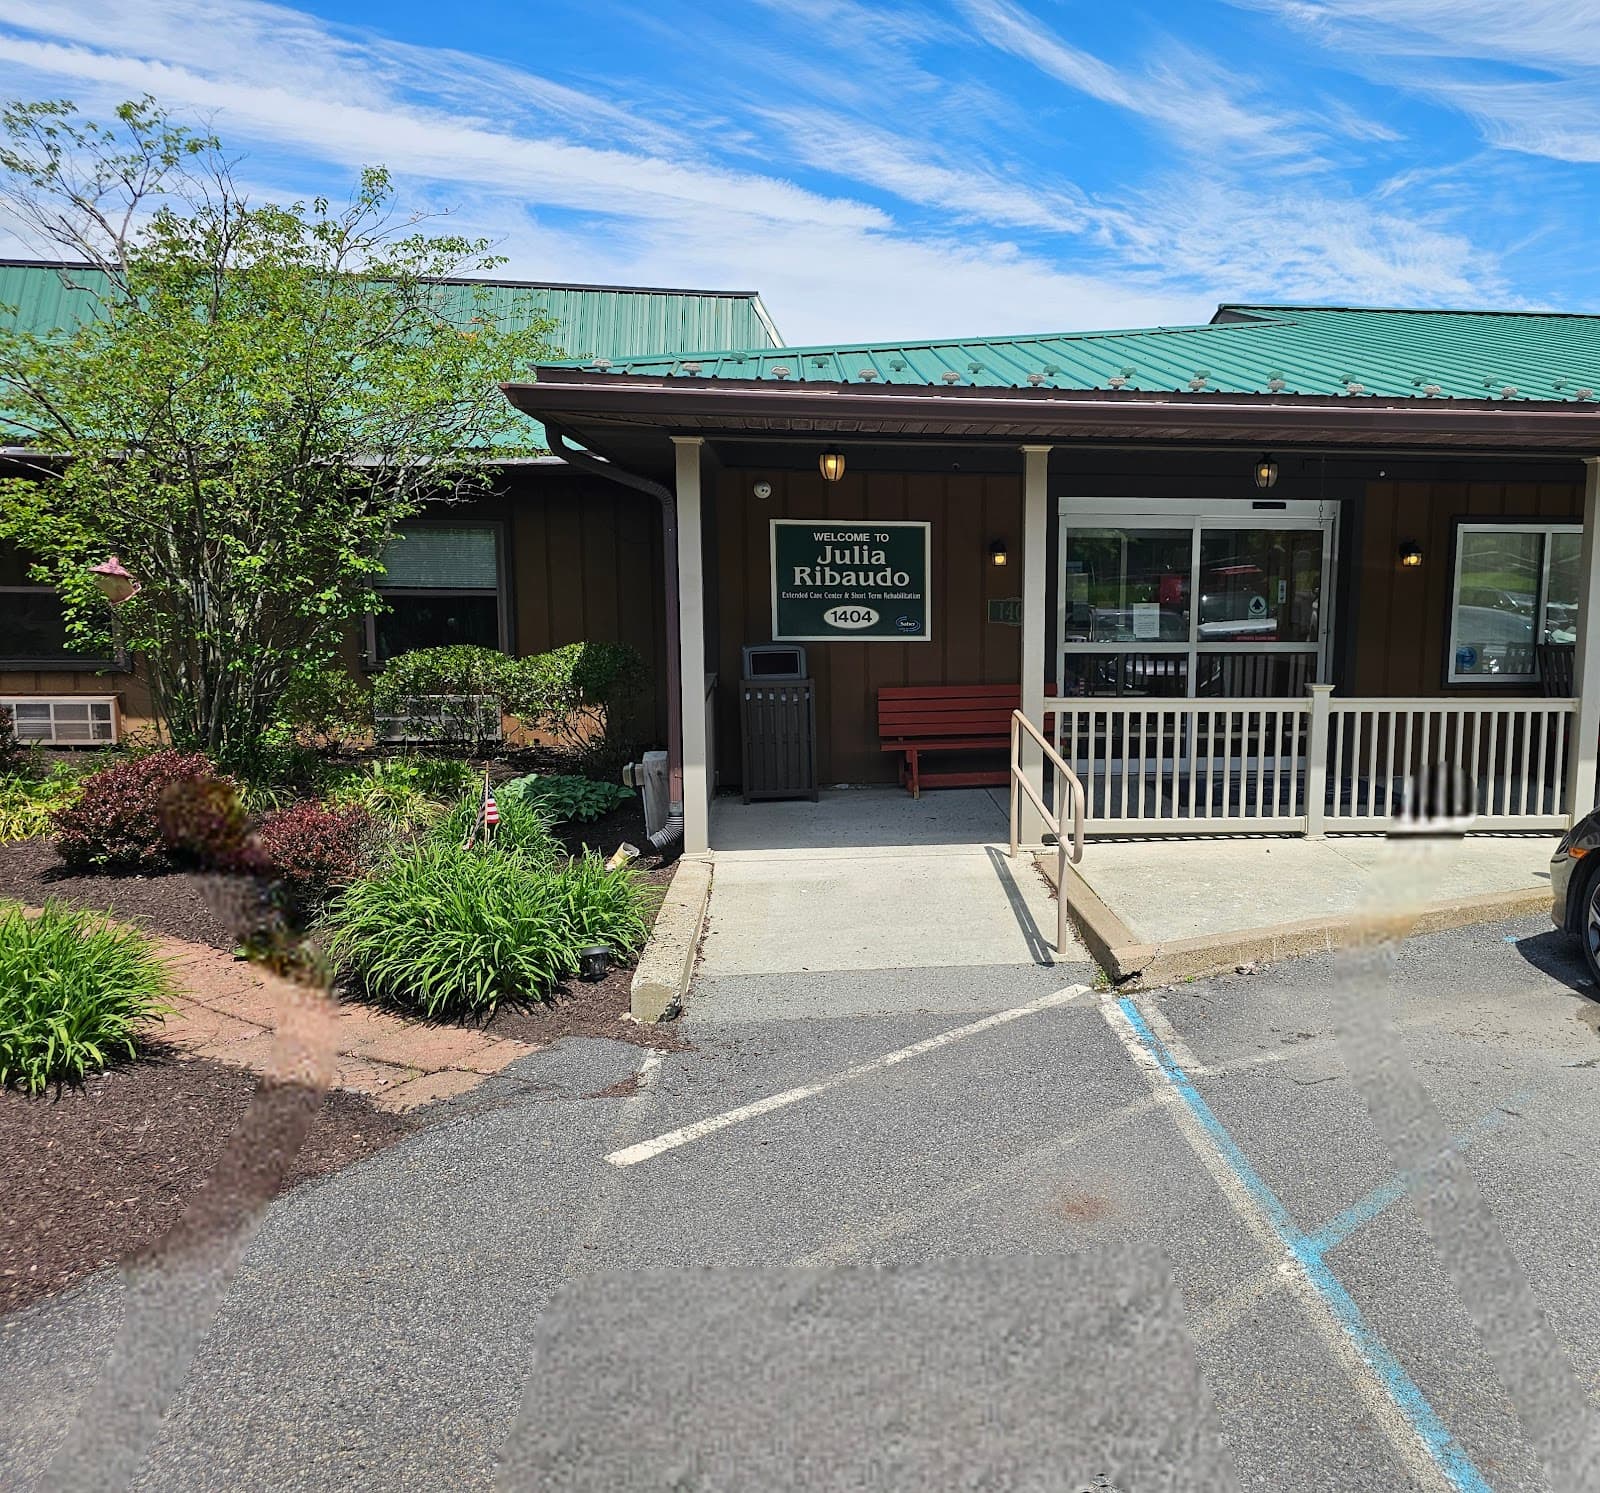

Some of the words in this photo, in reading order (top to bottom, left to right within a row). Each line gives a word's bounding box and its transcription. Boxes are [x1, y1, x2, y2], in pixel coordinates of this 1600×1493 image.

[813, 532, 870, 542] WELCOME
[874, 533, 890, 542] TO
[816, 545, 886, 565] Julia
[793, 566, 910, 587] Ribaudo
[782, 591, 809, 599] Extended
[851, 592, 866, 600] Short
[868, 592, 882, 600] Term
[883, 592, 921, 600] Rehabilitation
[830, 610, 873, 623] 1404
